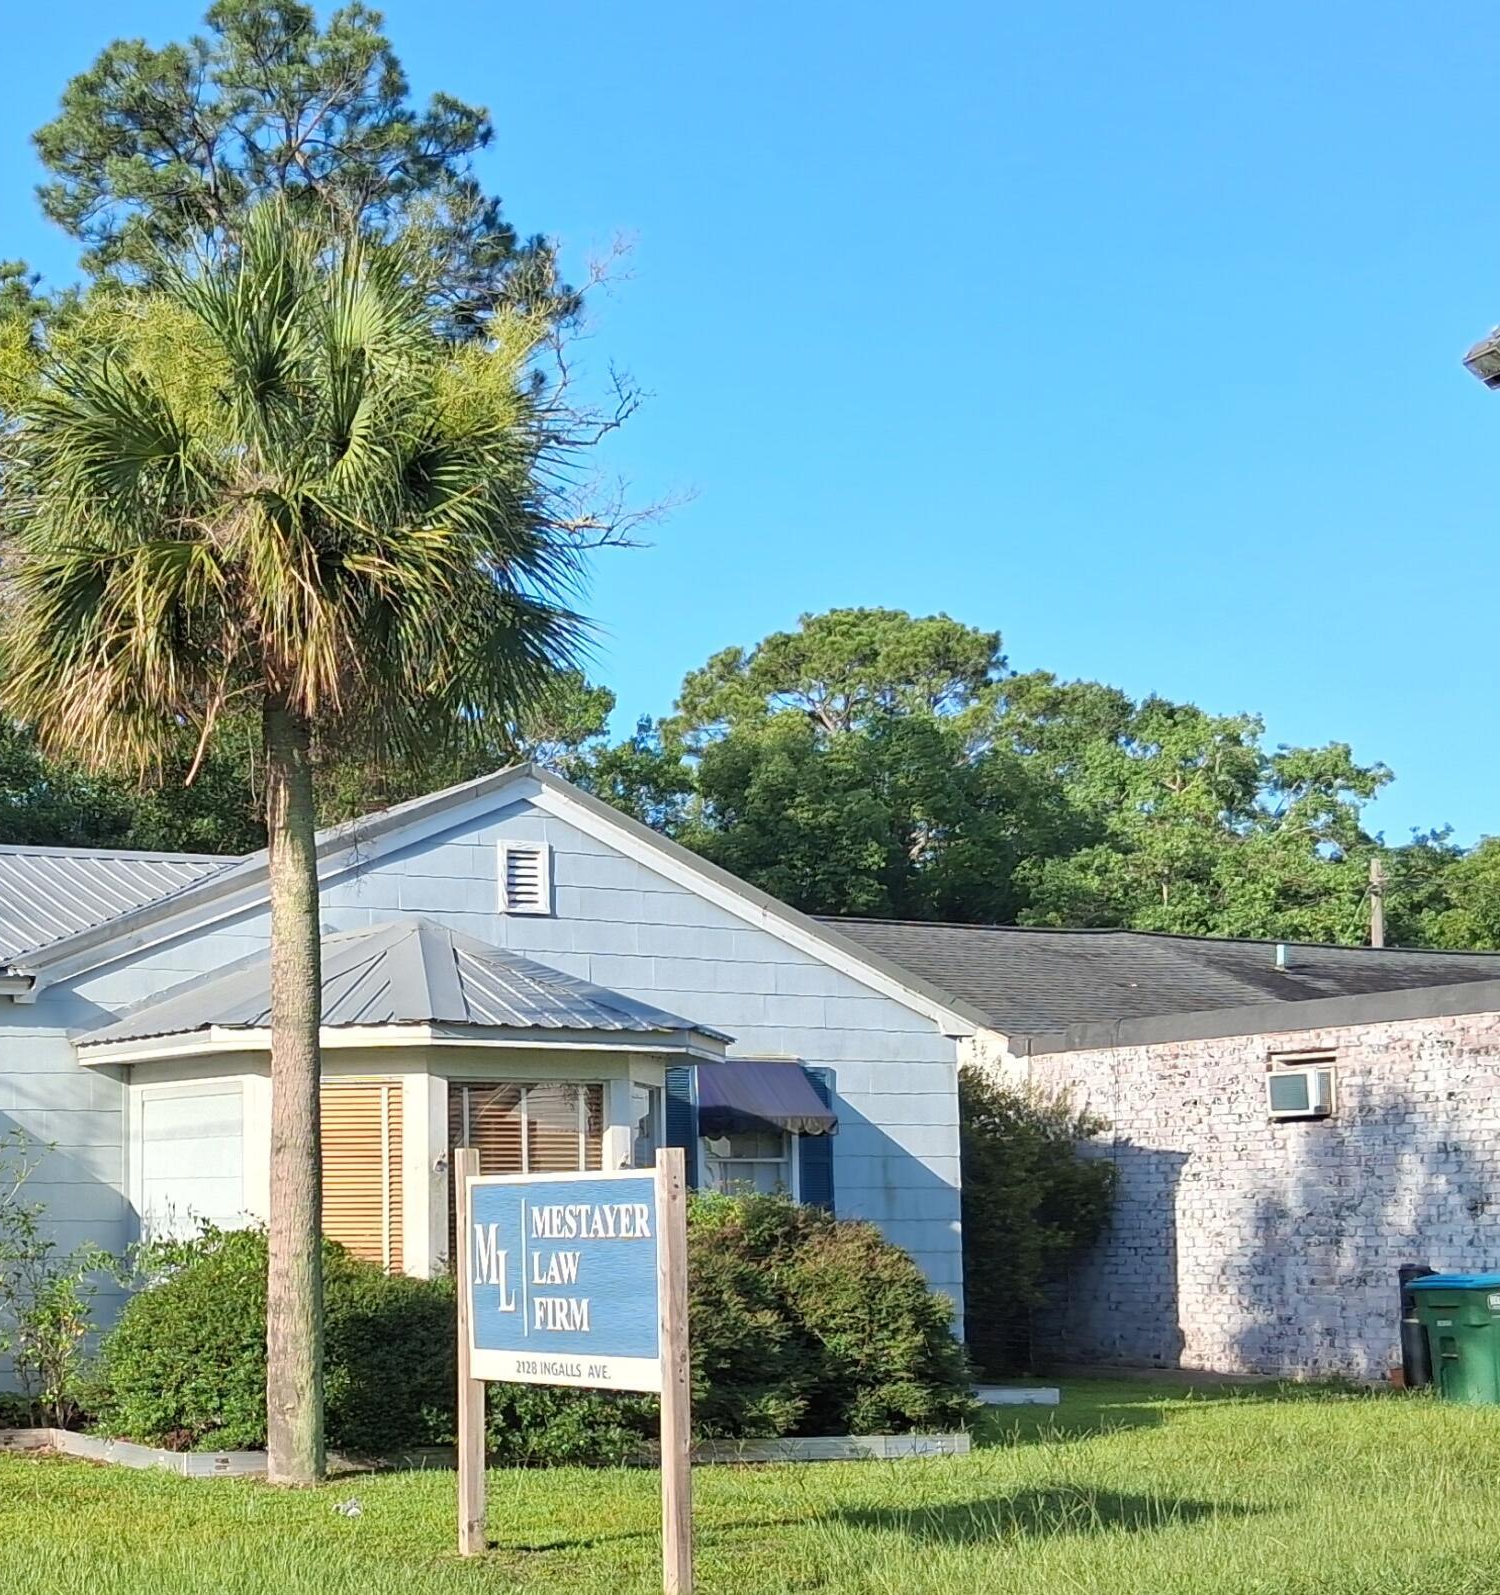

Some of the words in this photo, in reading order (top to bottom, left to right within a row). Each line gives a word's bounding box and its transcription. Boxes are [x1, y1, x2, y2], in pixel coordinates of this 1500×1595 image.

[531, 1203, 652, 1239] MESTAYER
[532, 1251, 581, 1285] LAW
[533, 1297, 590, 1332] FIRM
[516, 1360, 537, 1375] 2128
[540, 1362, 581, 1378] INGALLS
[588, 1364, 611, 1380] AVE.
